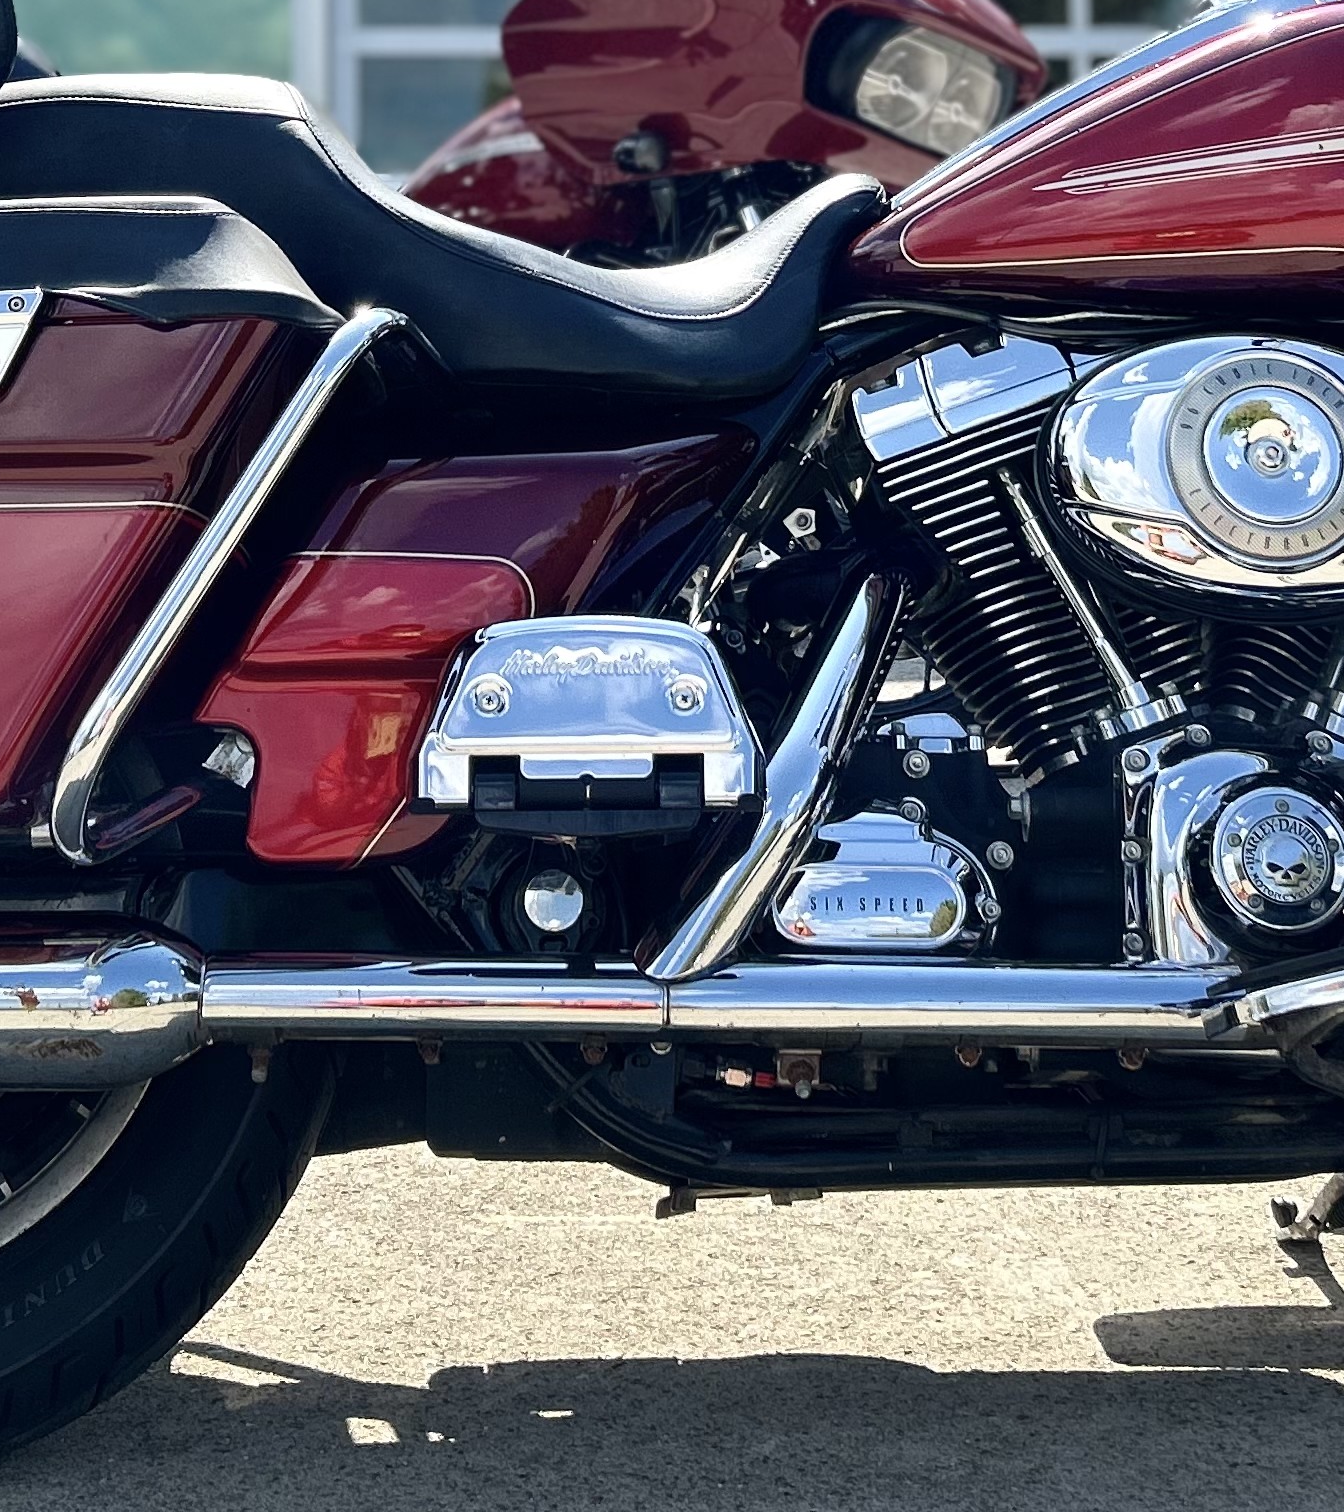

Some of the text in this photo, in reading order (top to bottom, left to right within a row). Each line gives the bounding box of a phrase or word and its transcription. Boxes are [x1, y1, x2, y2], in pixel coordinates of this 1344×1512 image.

[1203, 363, 1273, 396] CUBIC
[1252, 872, 1322, 901] MOTORCYCLES
[810, 896, 924, 912] SIX SPEED
